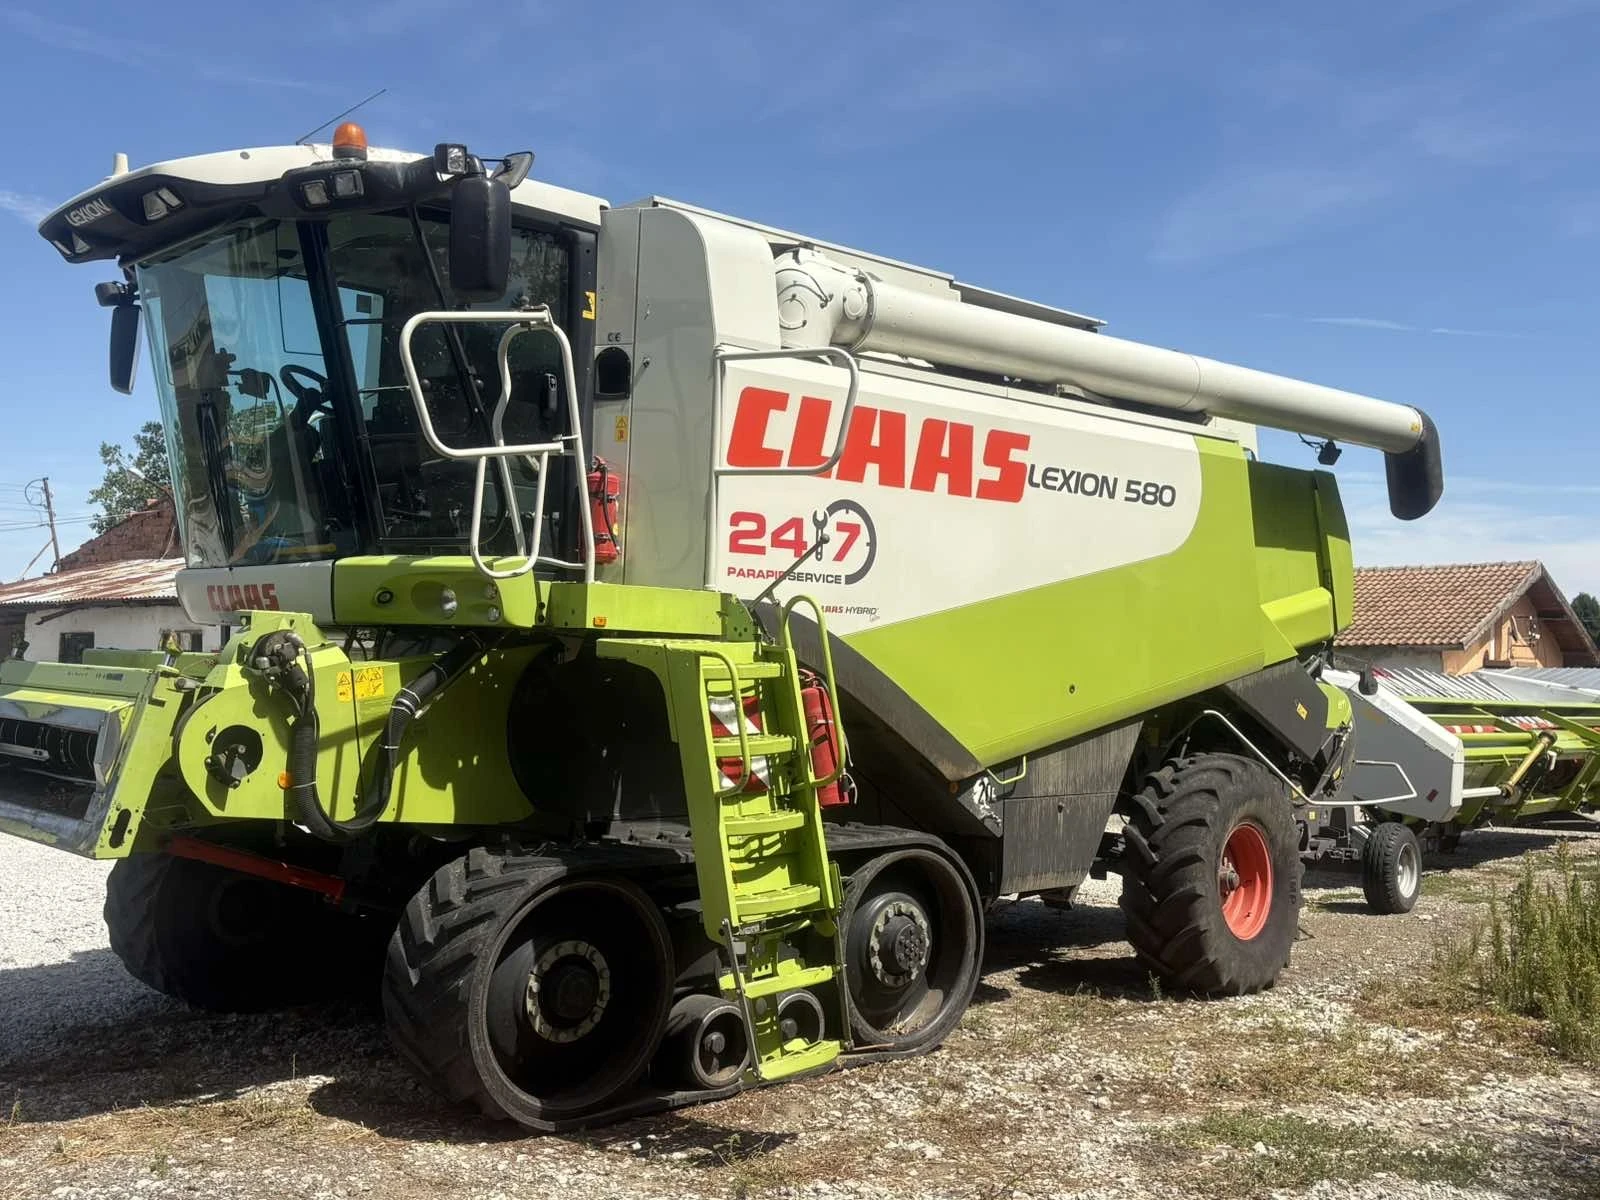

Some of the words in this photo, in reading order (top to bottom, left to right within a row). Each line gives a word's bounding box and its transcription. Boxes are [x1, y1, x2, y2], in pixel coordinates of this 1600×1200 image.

[64, 198, 112, 226] LEXION
[727, 386, 1031, 503] CLAAS
[1028, 463, 1119, 500] LEXION
[1124, 479, 1177, 507] 580
[207, 584, 280, 612] CLAAS
[821, 606, 844, 614] LAAS
[845, 606, 877, 615] HYBRID
